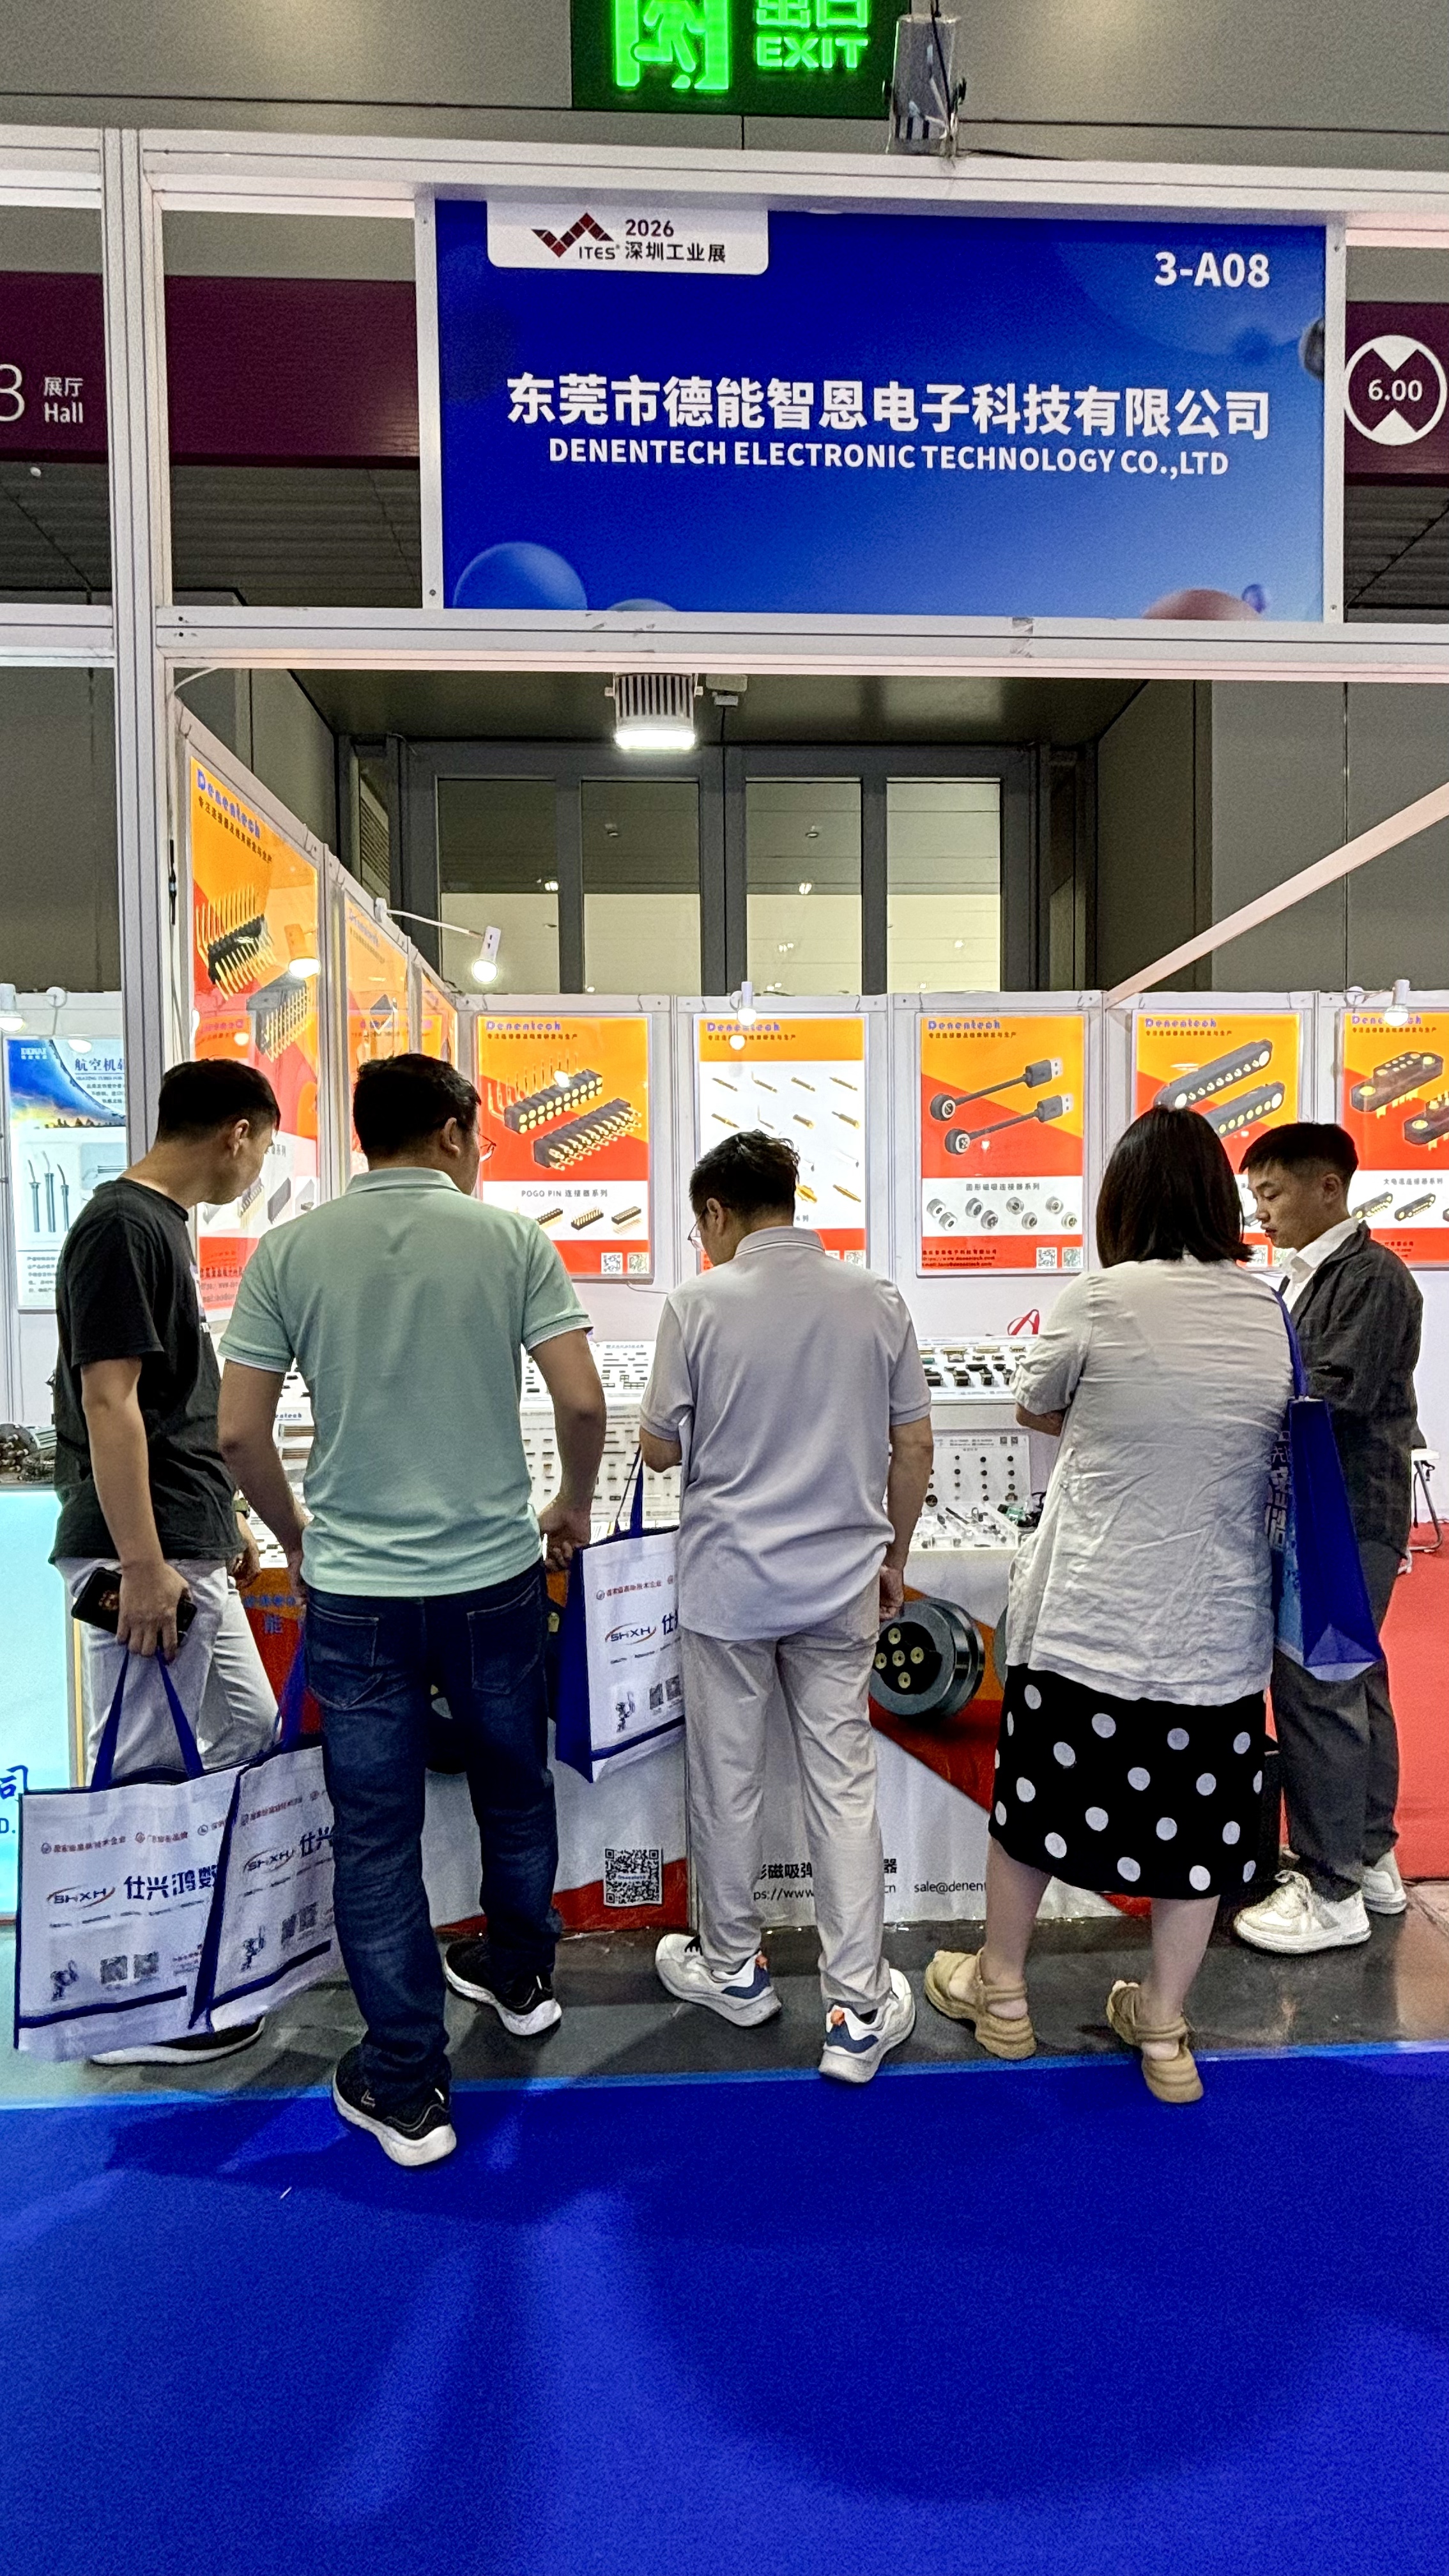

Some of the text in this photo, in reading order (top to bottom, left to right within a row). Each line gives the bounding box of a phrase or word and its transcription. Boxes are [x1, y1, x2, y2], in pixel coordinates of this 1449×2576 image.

[756, 36, 868, 68] EXIT
[625, 219, 674, 237] 2026
[625, 241, 726, 263] 深圳工业展
[1154, 252, 1269, 288] 3-A08
[43, 376, 83, 397] 展厅
[1368, 380, 1422, 401] 6.00
[44, 402, 83, 423] Hall
[507, 372, 1269, 440] 东莞市德能智恩电子科技有限公司
[550, 438, 1229, 480] DENENTECH ELECTRONIC TECHNOLOGY CO.,LTD
[1352, 1015, 1422, 1024] Denech
